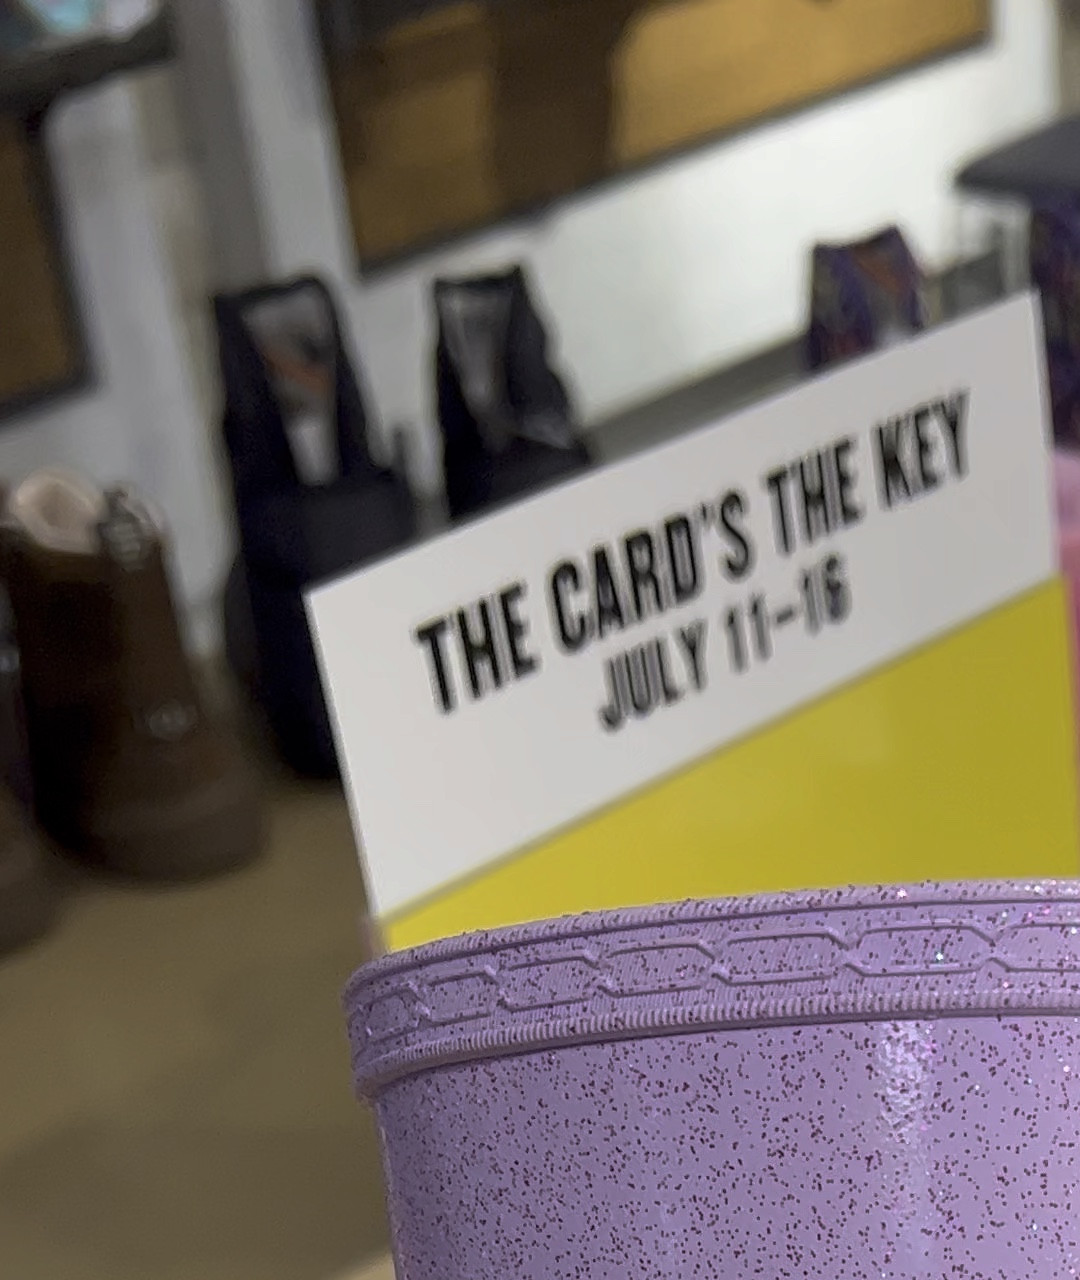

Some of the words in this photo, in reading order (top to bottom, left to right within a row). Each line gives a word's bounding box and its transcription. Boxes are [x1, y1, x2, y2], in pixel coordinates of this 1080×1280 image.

[415, 582, 538, 714] THE
[547, 489, 755, 654] CARD'S
[766, 435, 863, 554] THE
[873, 389, 973, 507] KEY
[599, 619, 709, 732] JULY
